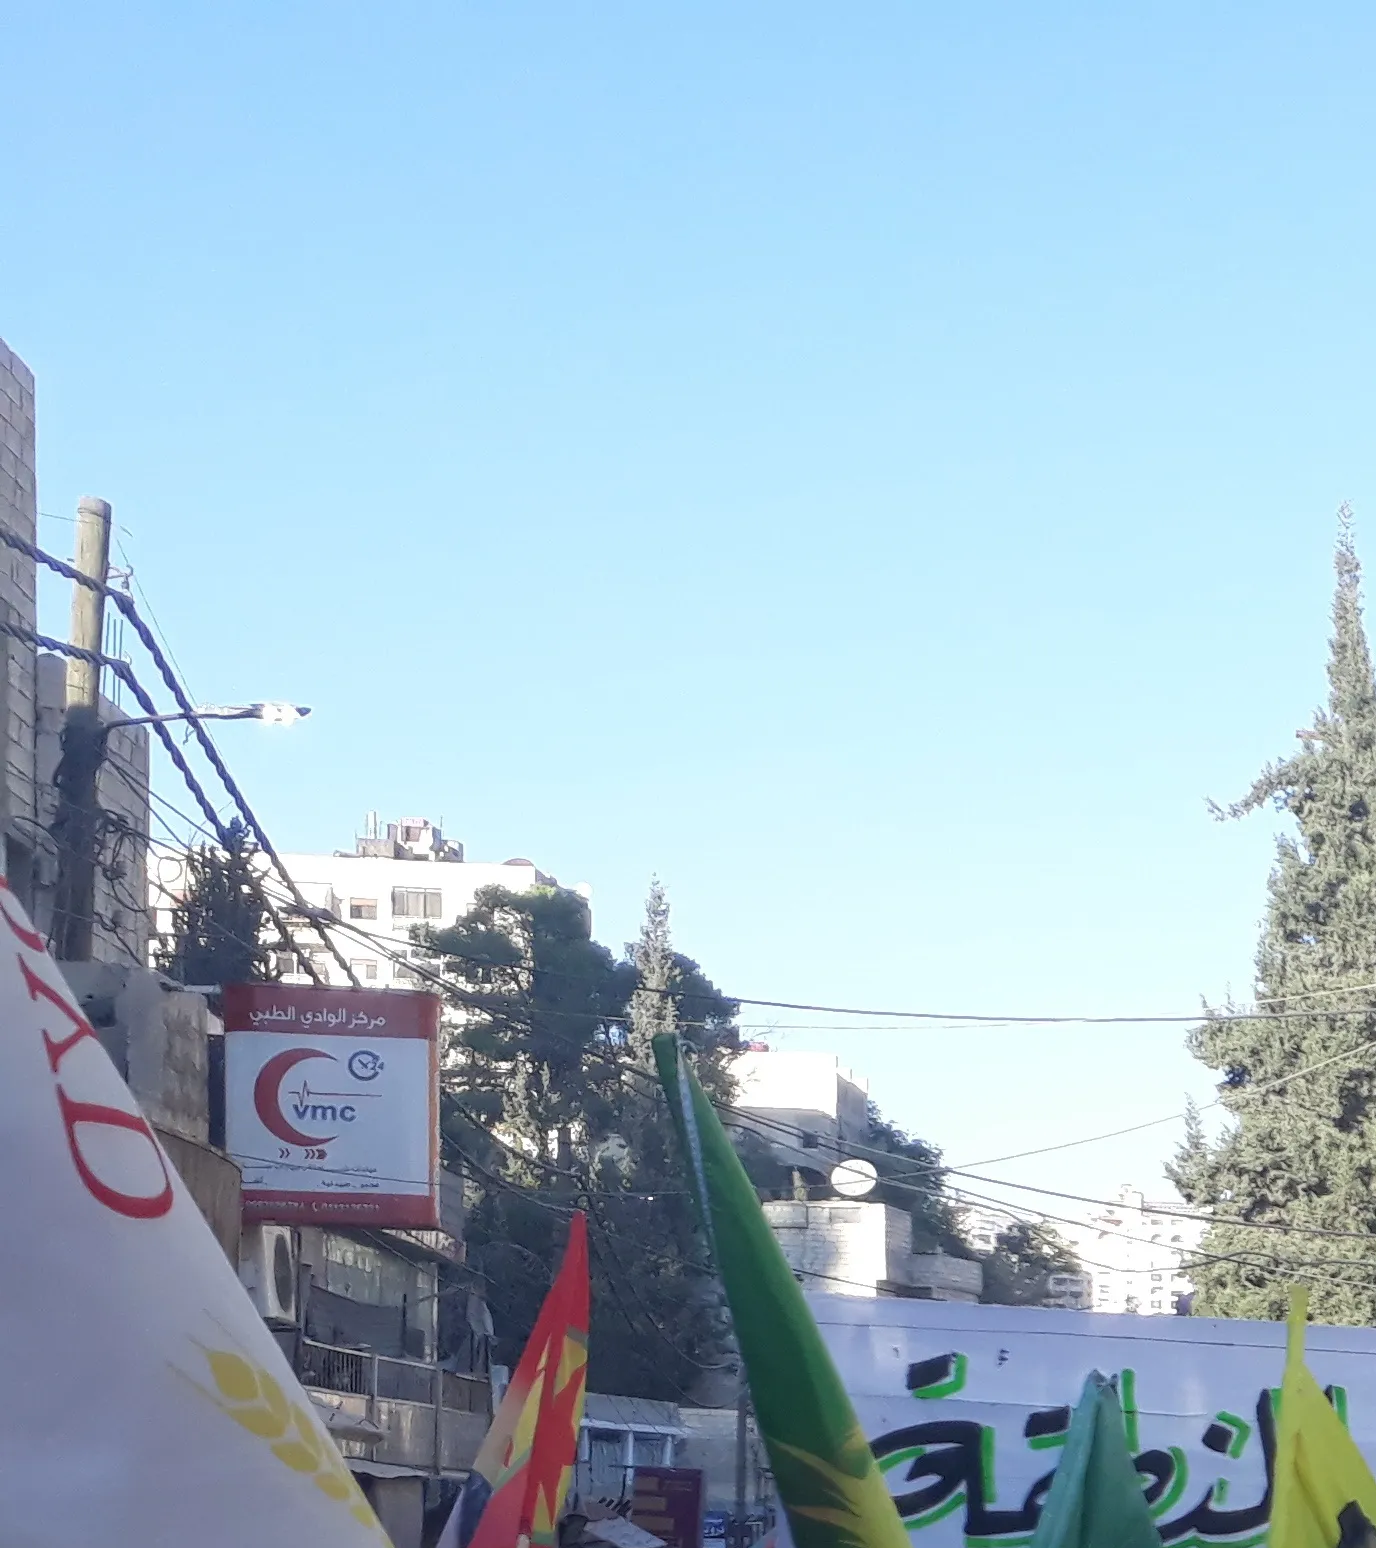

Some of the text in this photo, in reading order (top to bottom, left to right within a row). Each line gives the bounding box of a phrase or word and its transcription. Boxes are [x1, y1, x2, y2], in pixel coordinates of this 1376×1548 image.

[249, 1005, 387, 1029] مركز الوادي الطبي
[292, 1103, 358, 1123] vmc
